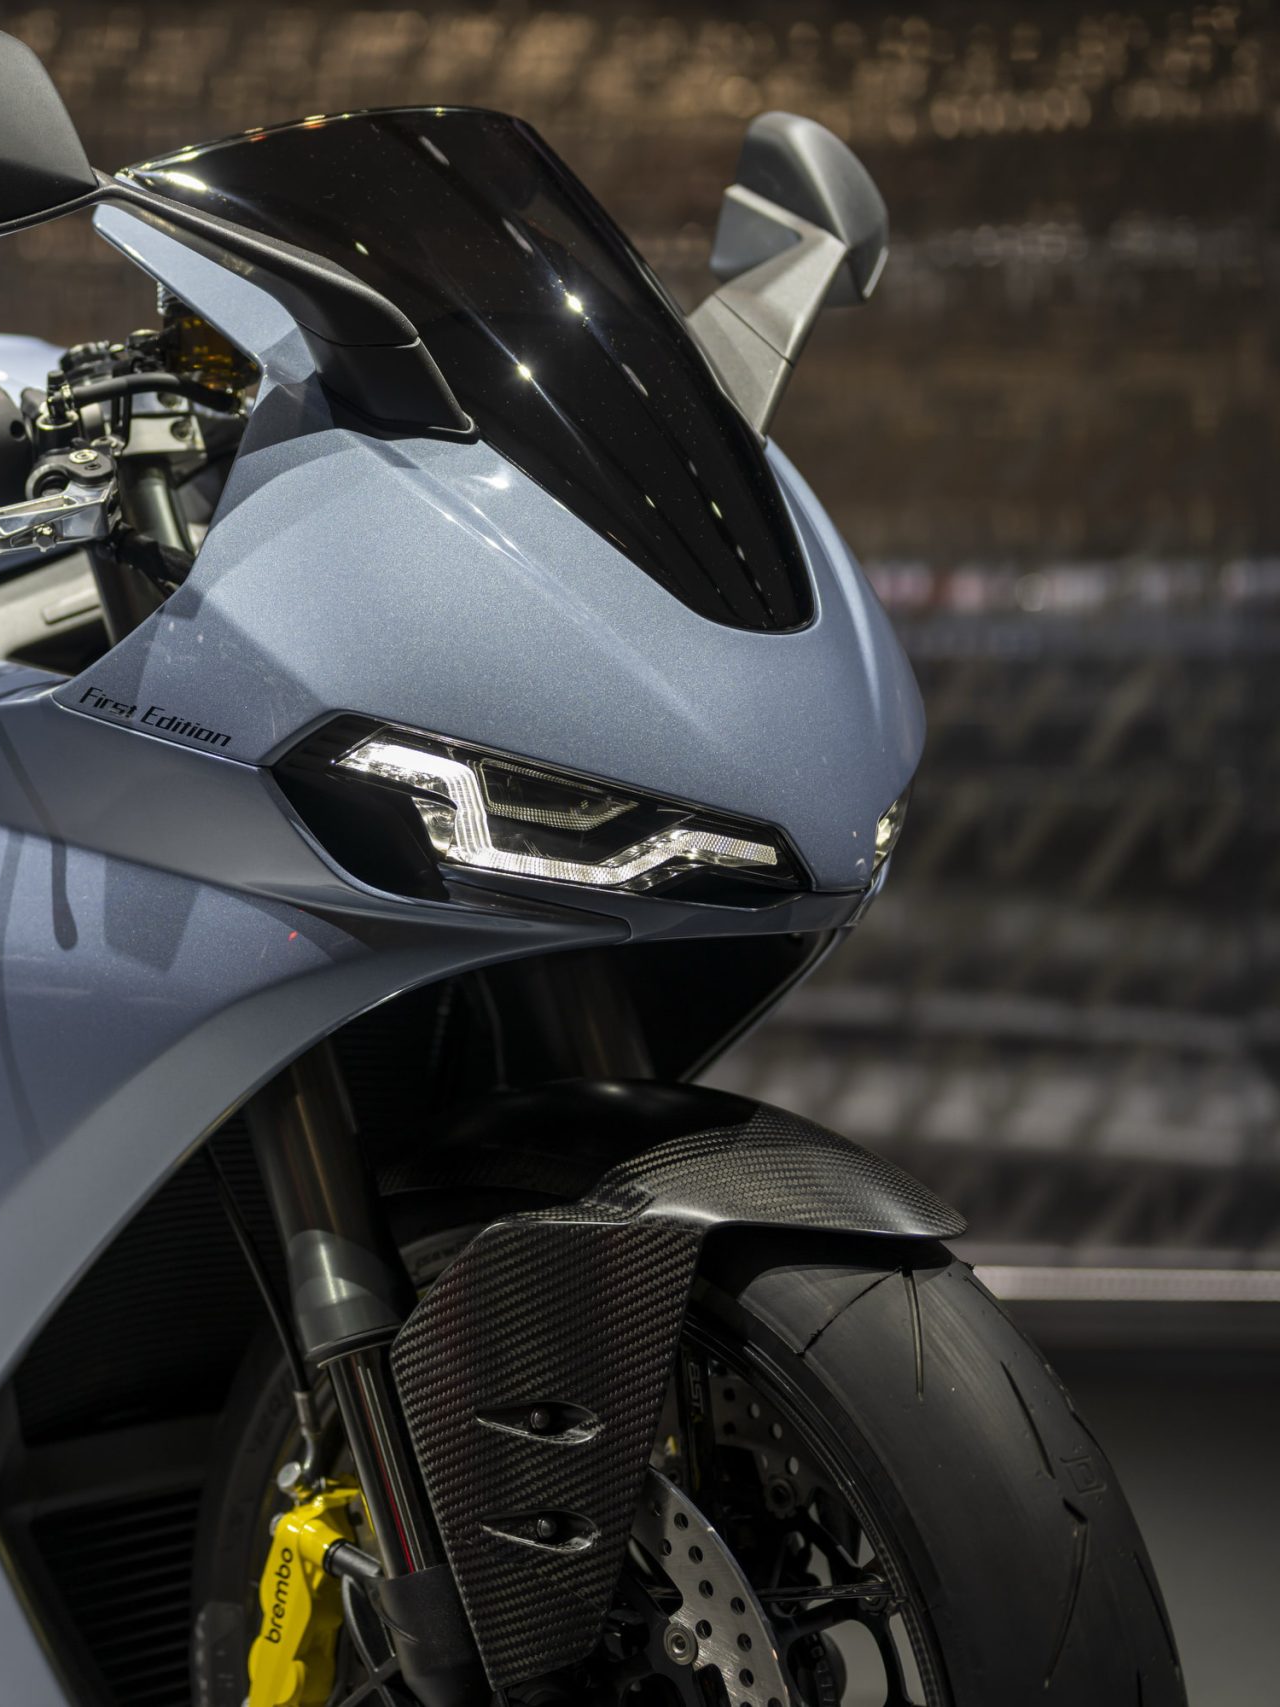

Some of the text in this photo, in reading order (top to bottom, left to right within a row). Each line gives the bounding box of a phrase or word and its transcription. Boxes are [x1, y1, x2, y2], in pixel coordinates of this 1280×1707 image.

[79, 686, 232, 747] First Edition
[264, 1547, 294, 1644] brembo
